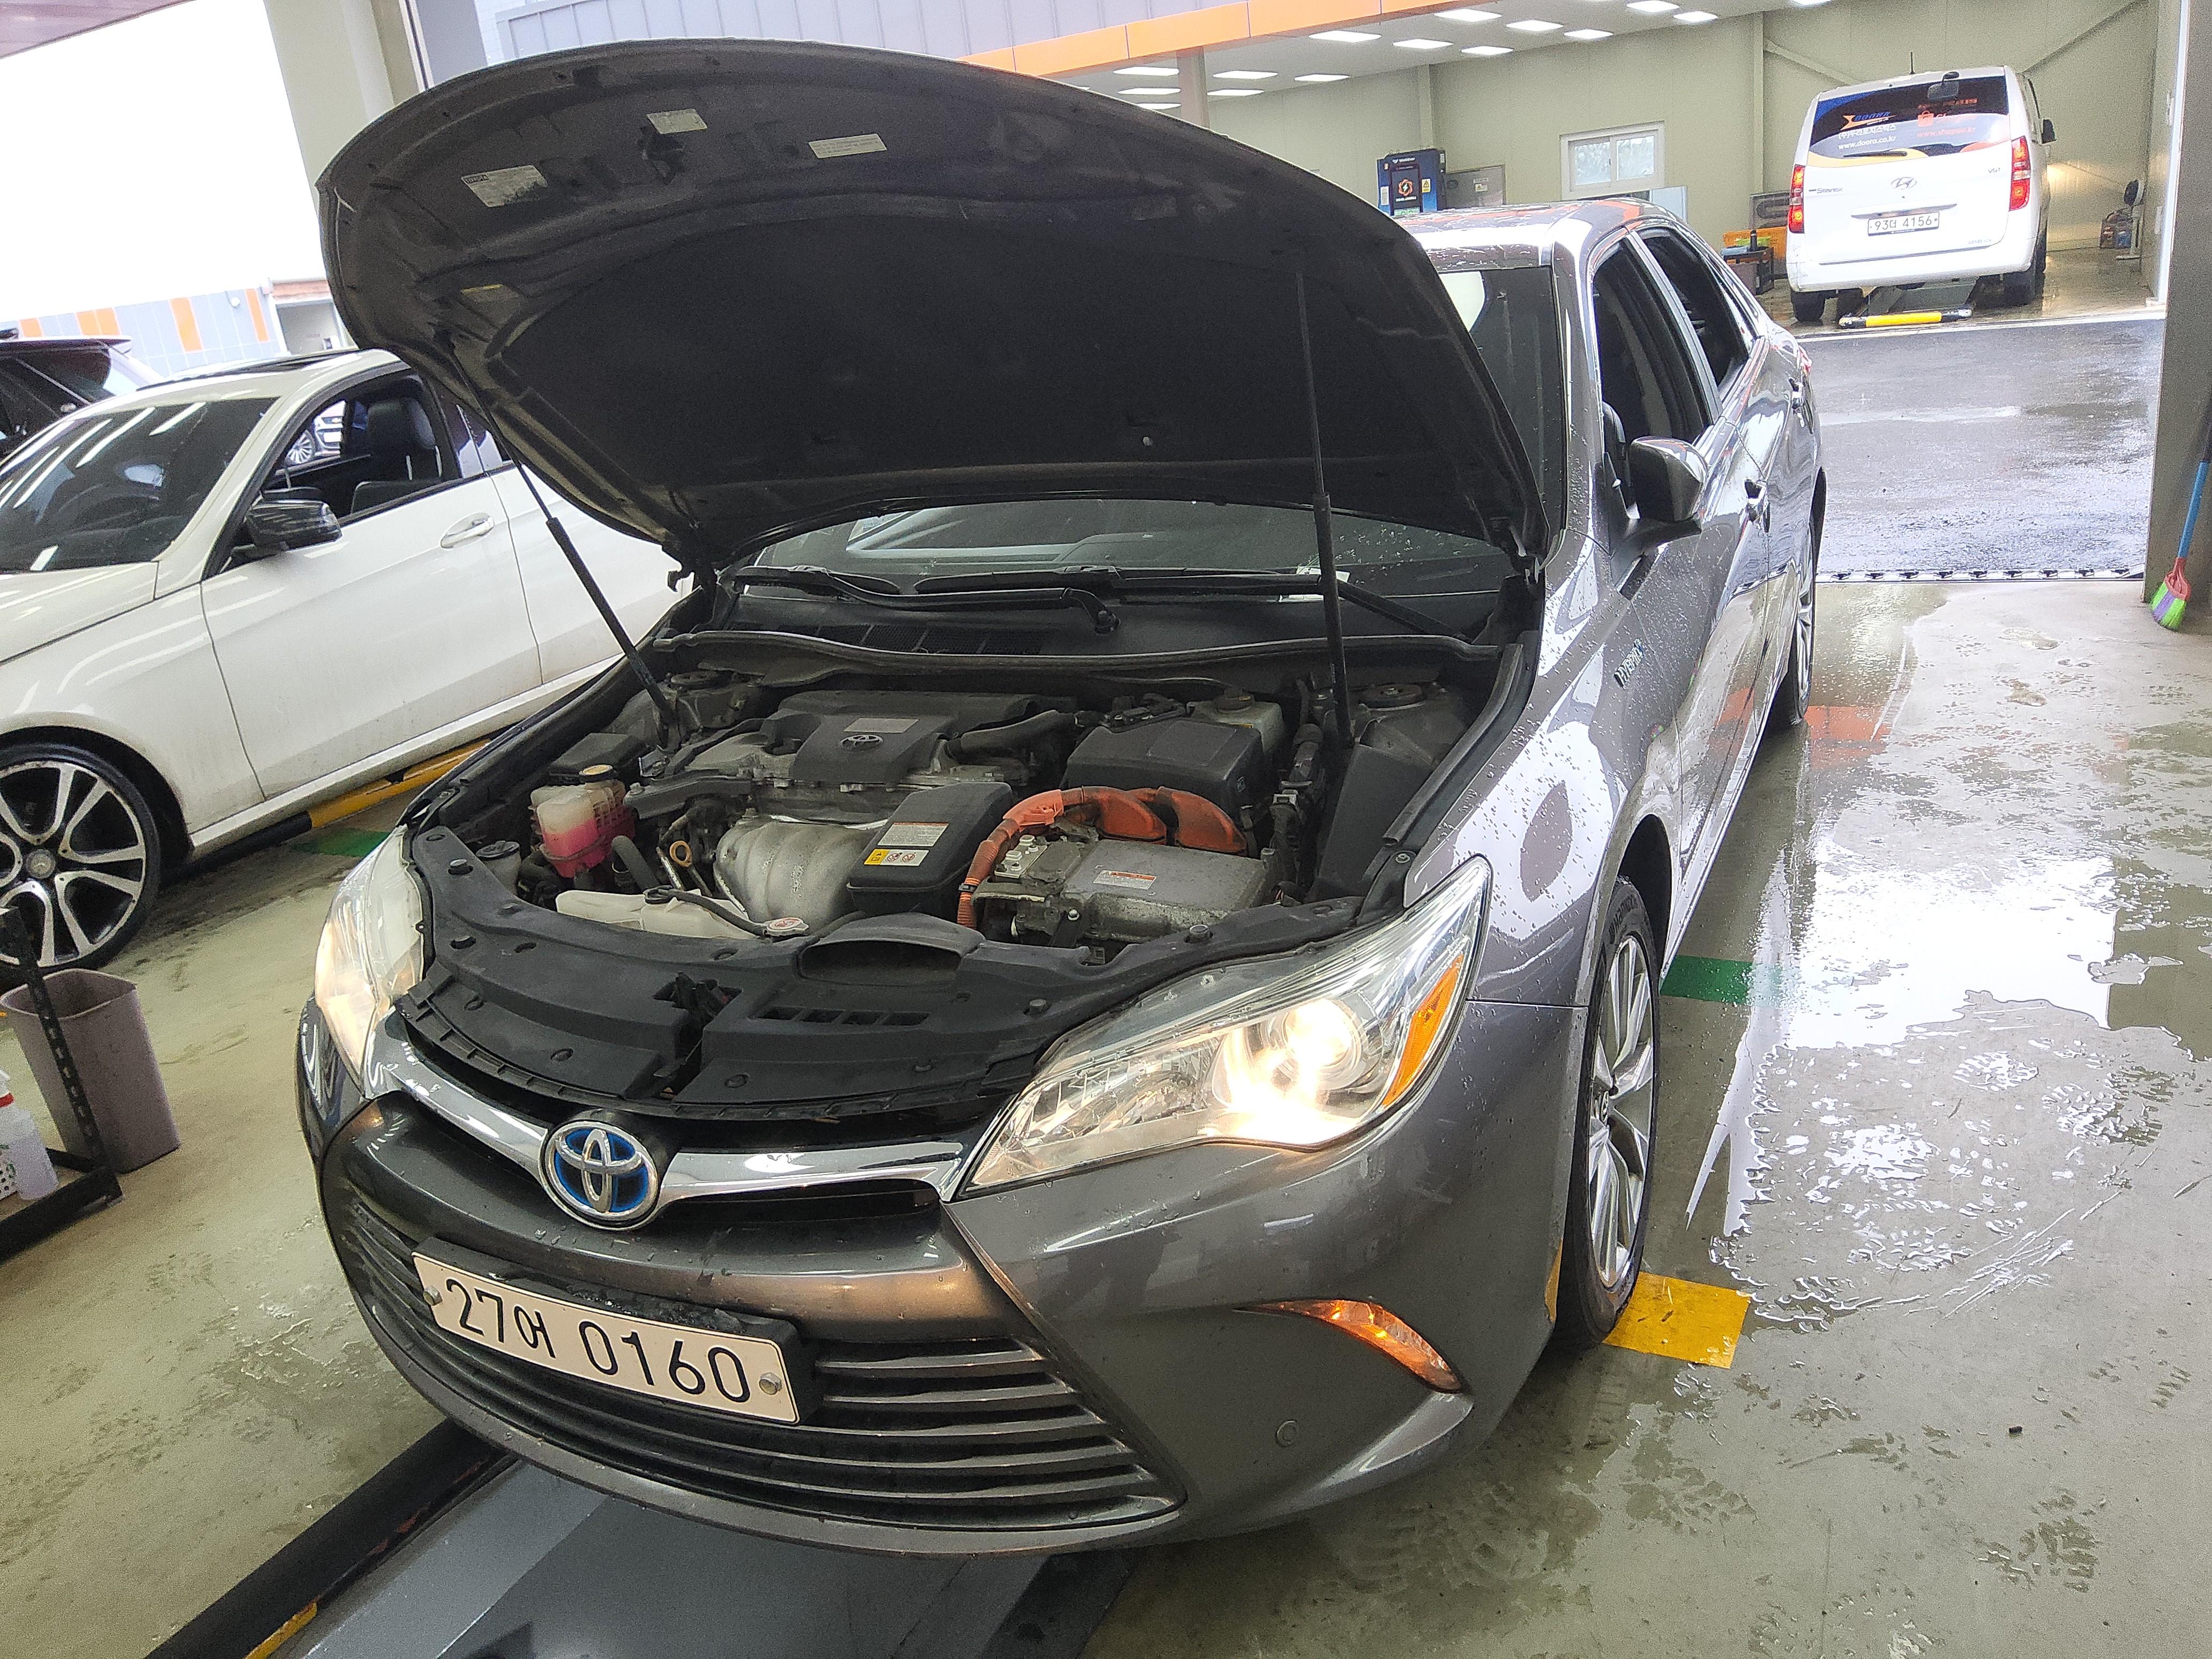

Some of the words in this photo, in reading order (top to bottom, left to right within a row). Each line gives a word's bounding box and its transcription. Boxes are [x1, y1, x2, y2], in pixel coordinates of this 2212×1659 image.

[1838, 135, 1896, 150] www.doora.co.kr
[1875, 219, 1896, 231] 93더
[1902, 215, 1932, 227] 4156
[446, 1278, 557, 1359] 27어
[578, 1320, 751, 1403] 0160
